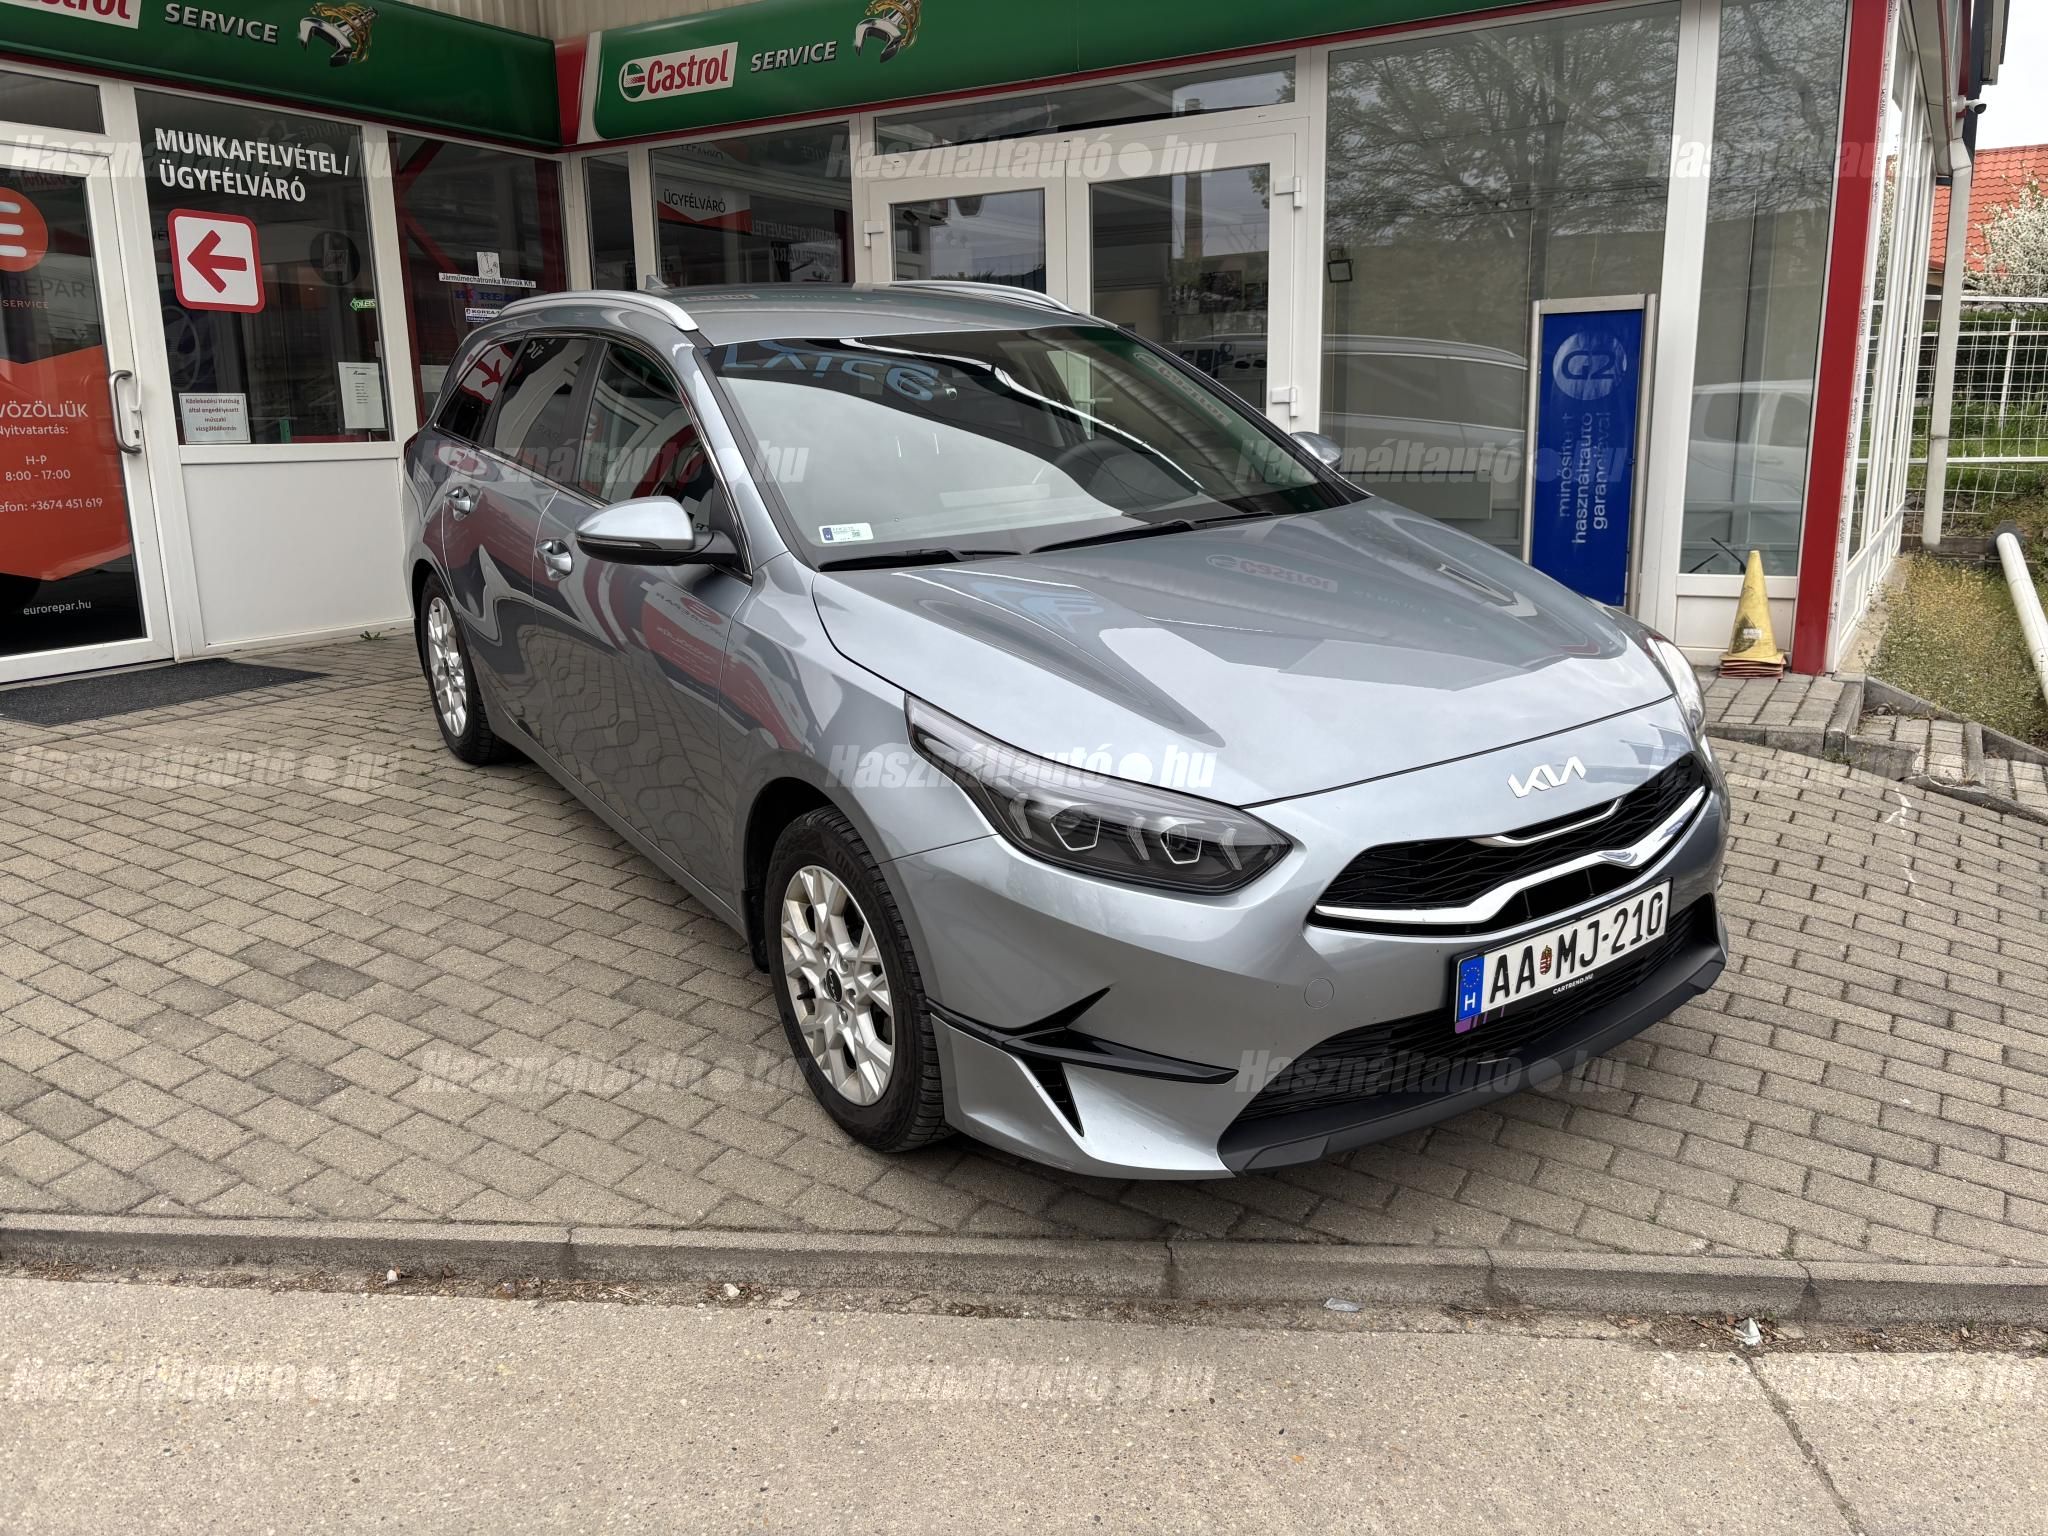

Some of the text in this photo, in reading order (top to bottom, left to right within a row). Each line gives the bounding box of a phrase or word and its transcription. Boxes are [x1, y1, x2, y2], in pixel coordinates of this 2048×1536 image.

[164, 3, 279, 43] SERVICE
[647, 41, 837, 94] Castrol SERVICE
[159, 163, 306, 203] ÜGYFÉLVÁRÓ
[663, 188, 726, 214] ÜGYFÉLVÁRÓ
[2, 299, 49, 309] SERVICE
[1561, 350, 1617, 381] G2
[25, 455, 47, 465] H-P
[5, 470, 32, 481] 8:00
[41, 469, 71, 480] 17:00
[30, 500, 63, 511] +3674
[65, 499, 83, 509] 451
[85, 497, 103, 508] 619
[23, 601, 92, 615] eurorepar.hu
[1463, 890, 1664, 1012] H AA MJ-210
